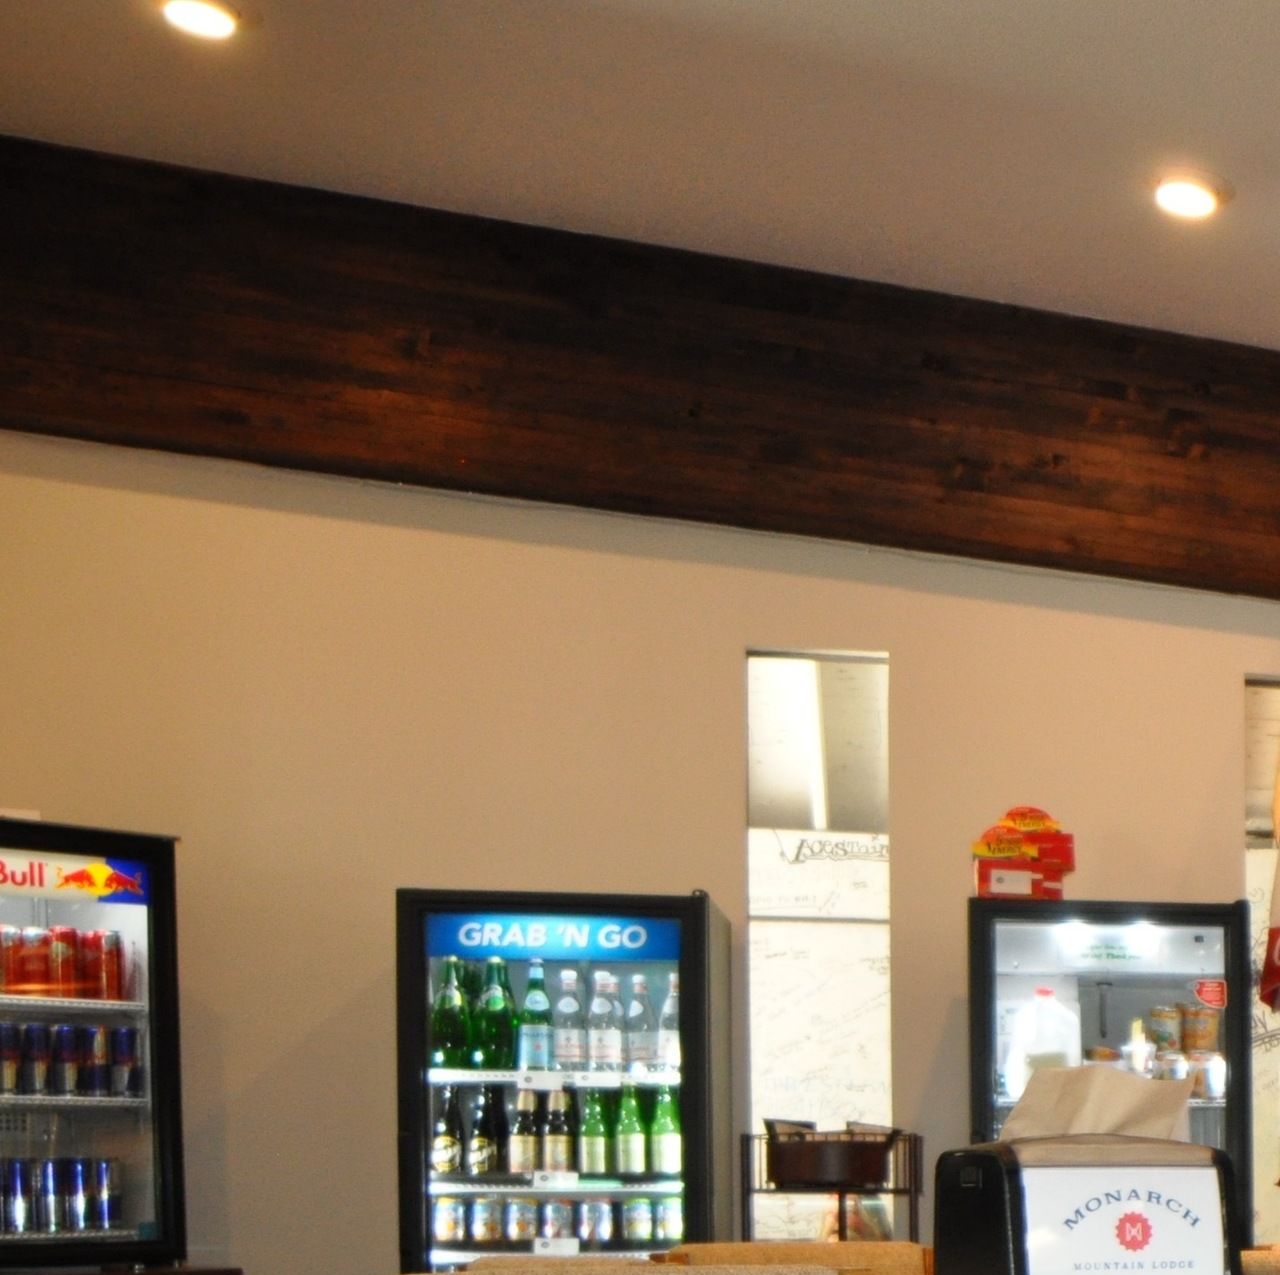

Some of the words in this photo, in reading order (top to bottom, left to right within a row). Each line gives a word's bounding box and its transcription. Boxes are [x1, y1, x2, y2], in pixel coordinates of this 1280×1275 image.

[458, 921, 547, 947] GRAB
[556, 923, 591, 948] 'N
[597, 924, 648, 949] GO
[1062, 1188, 1201, 1231] MONARCH
[1073, 1261, 1145, 1271] MOUNTAIN
[1152, 1260, 1195, 1270] LODGE
